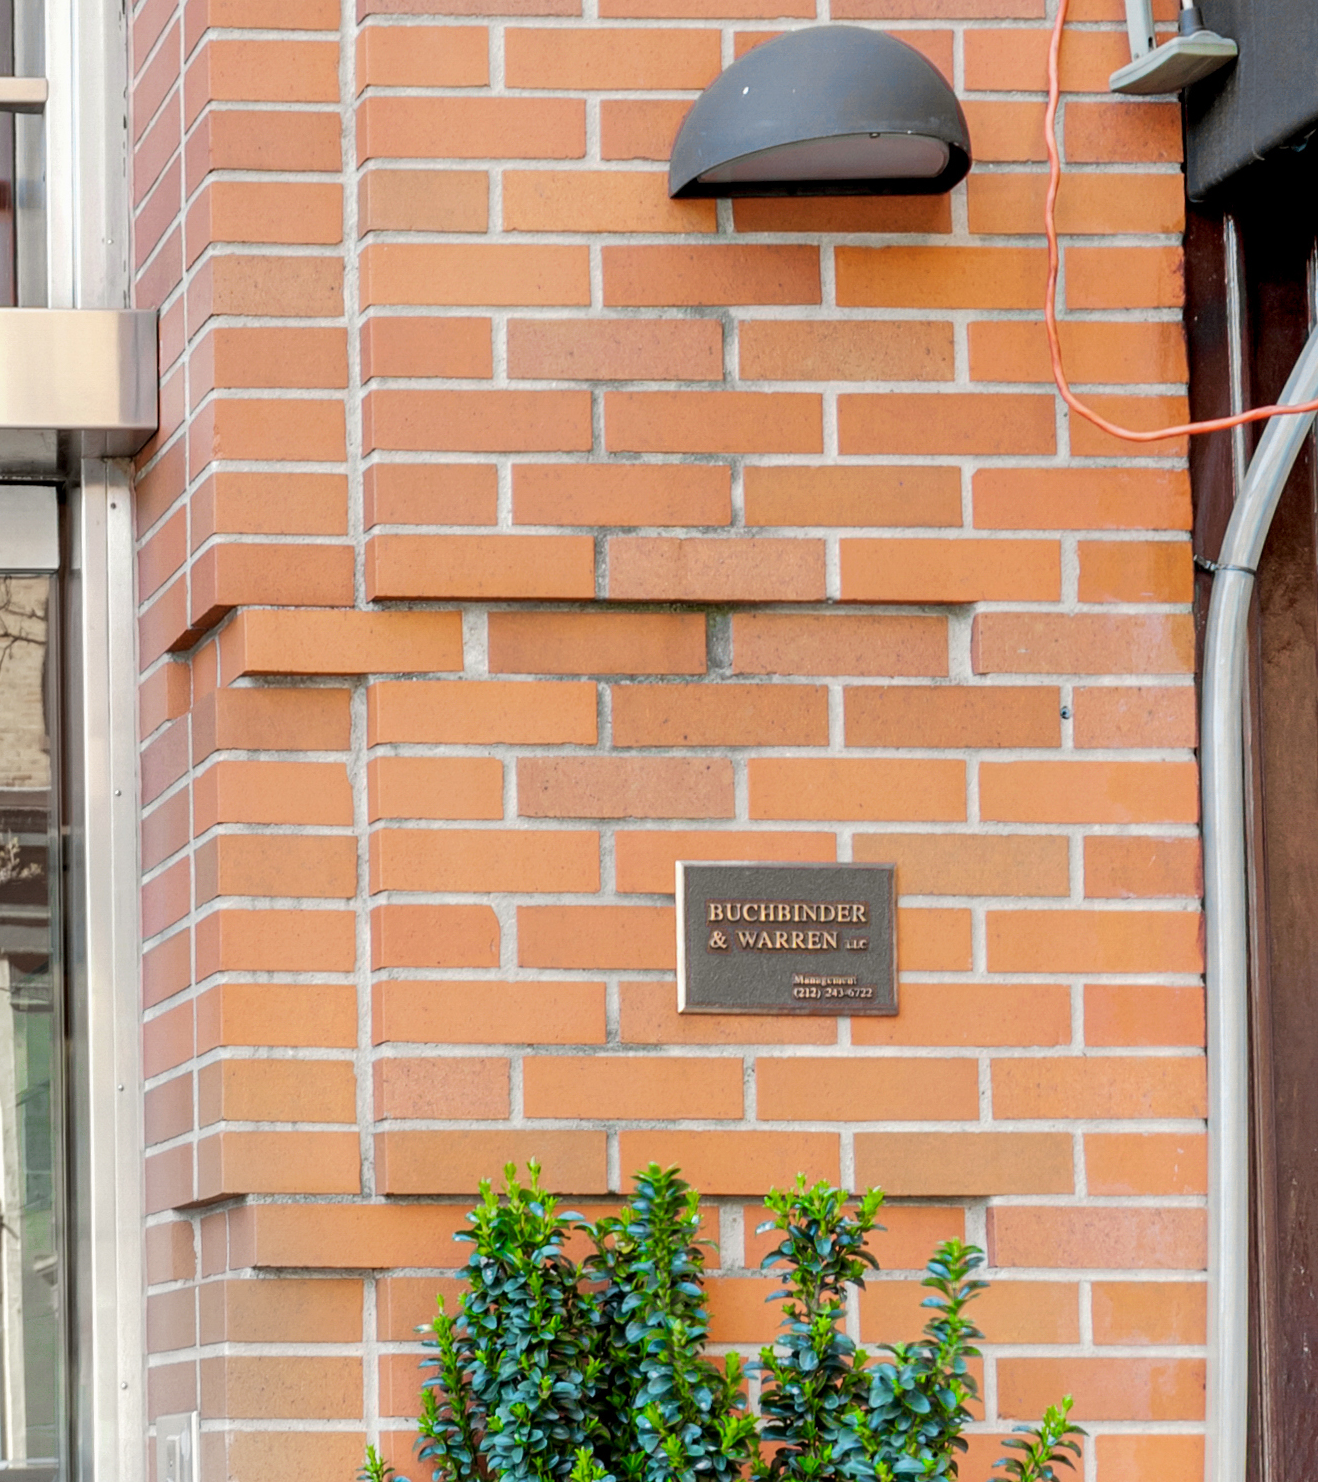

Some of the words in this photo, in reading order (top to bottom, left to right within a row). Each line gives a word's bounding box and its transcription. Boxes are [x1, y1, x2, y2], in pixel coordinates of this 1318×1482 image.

[708, 902, 867, 923] BUCHBINDER
[709, 930, 728, 949] &
[735, 930, 839, 950] WARREN
[844, 938, 868, 950] LLC
[793, 973, 857, 987] Management
[793, 987, 821, 1000] (212)
[825, 987, 873, 999] 243-6722
